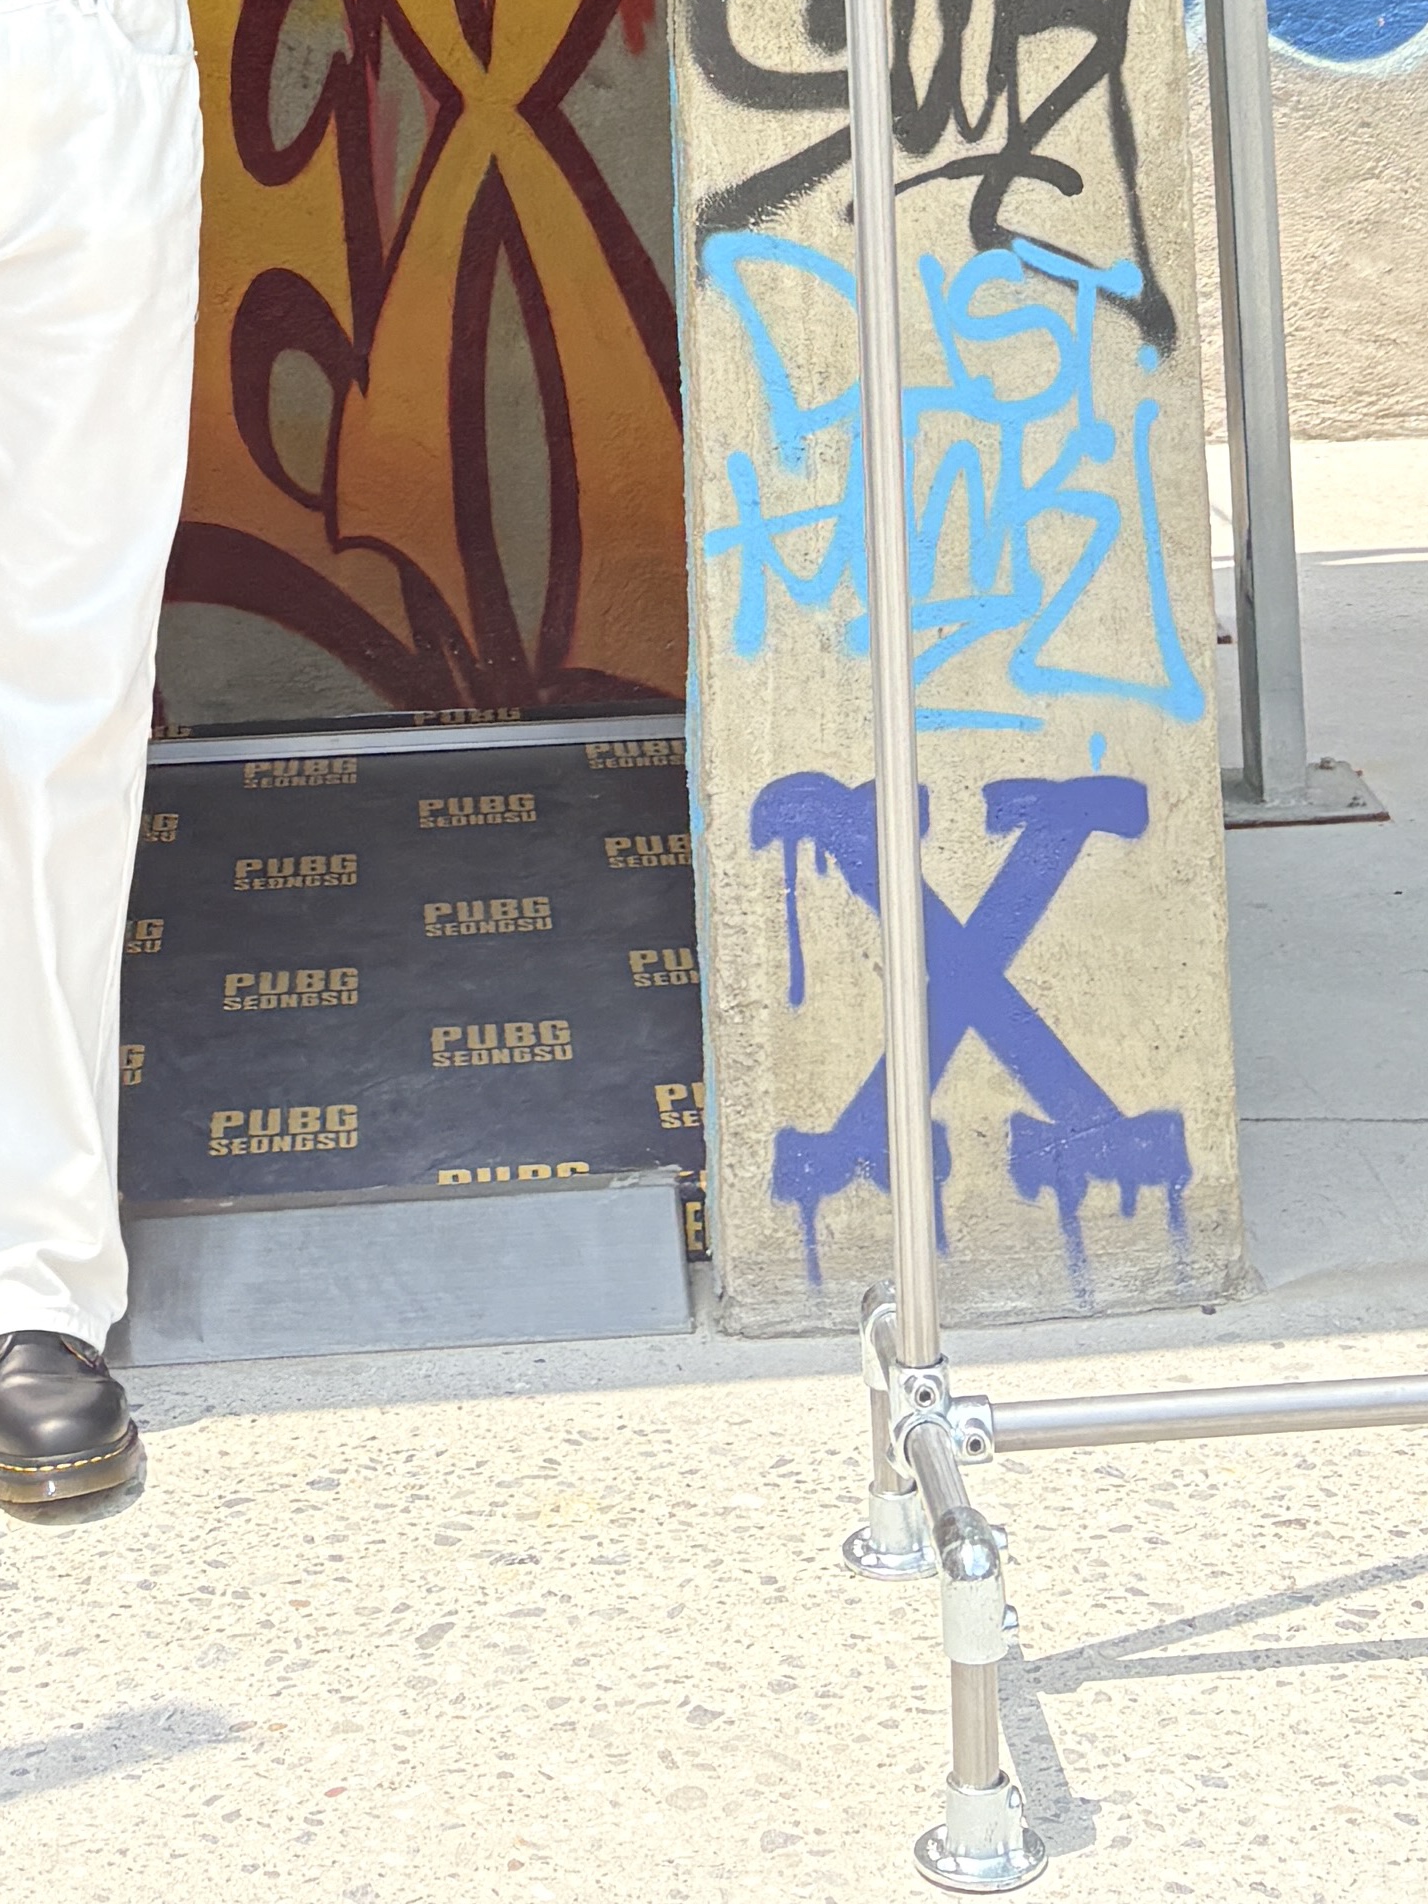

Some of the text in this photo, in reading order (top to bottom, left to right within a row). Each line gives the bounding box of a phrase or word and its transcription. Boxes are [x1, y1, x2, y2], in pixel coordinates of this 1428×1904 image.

[418, 793, 537, 818] PUBG
[234, 853, 358, 880] PUBG
[423, 896, 552, 924] PUBG
[223, 967, 360, 997] PUBG
[430, 1019, 571, 1052] PUBG
[209, 1104, 359, 1139] PUBG
